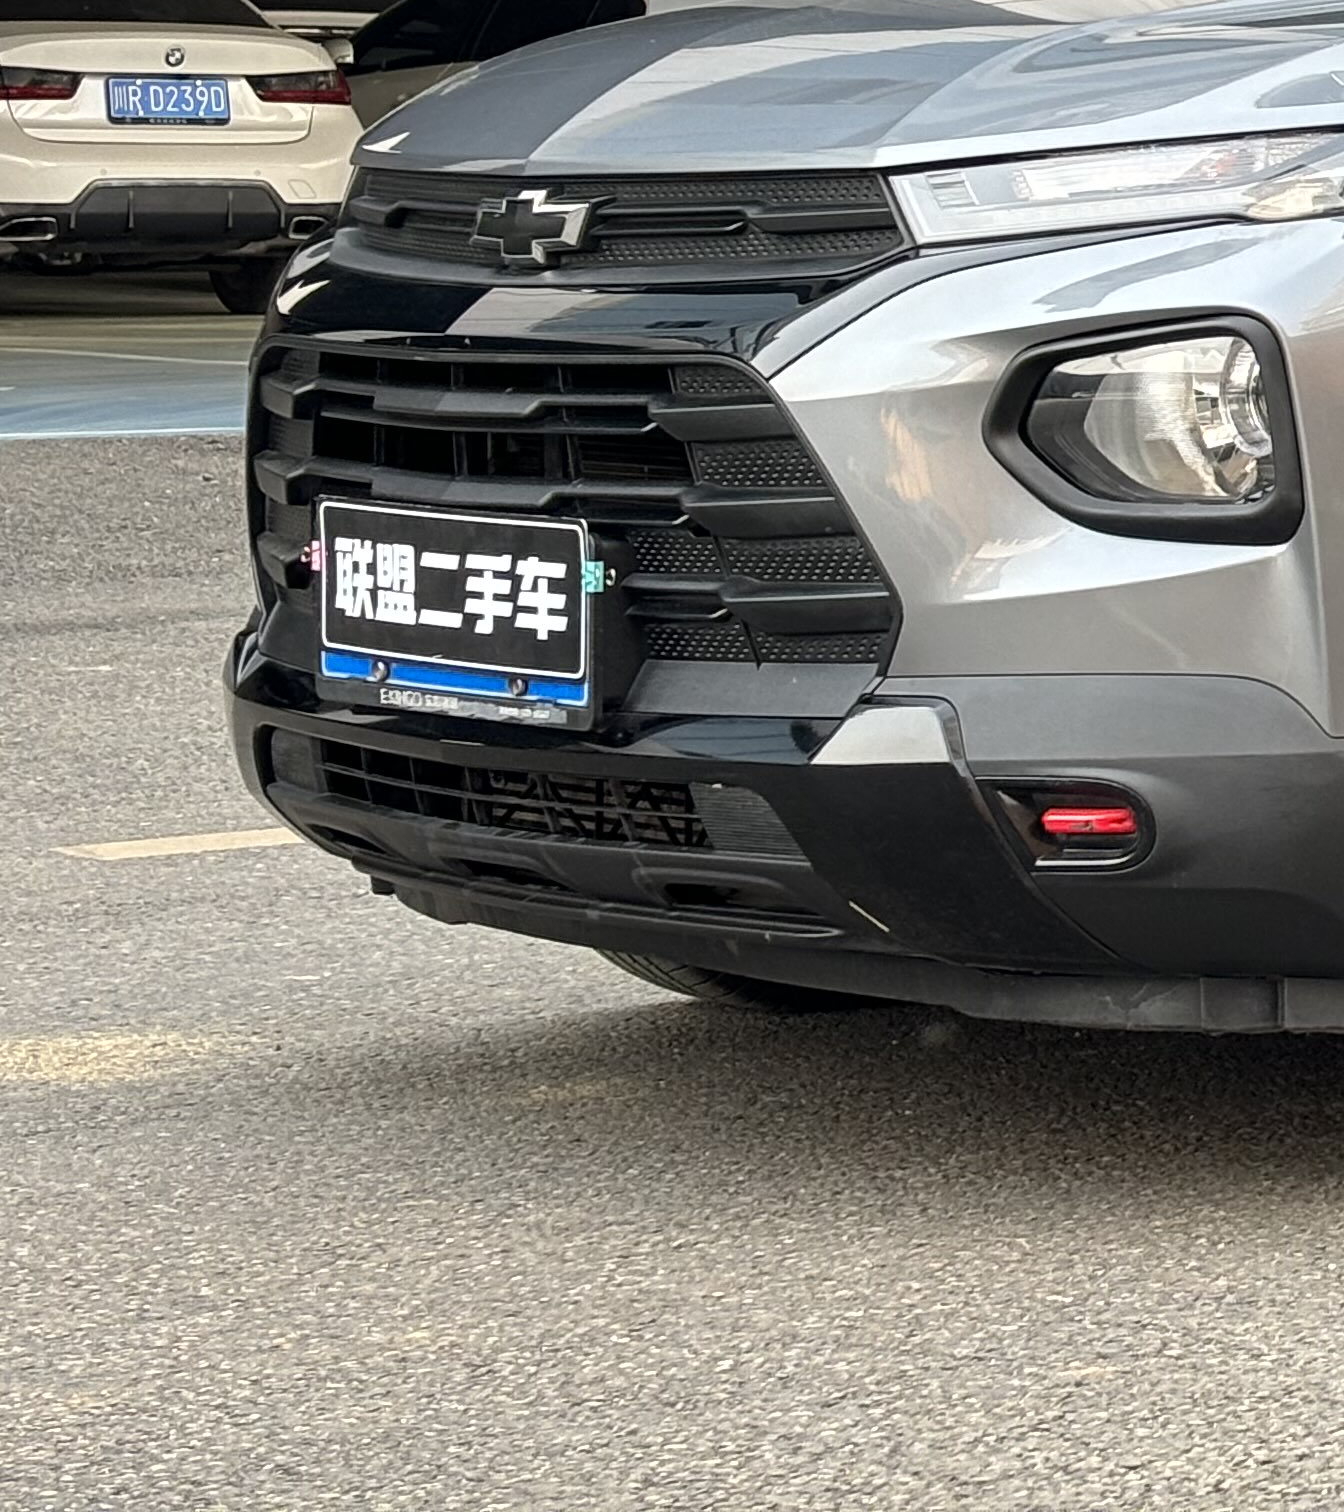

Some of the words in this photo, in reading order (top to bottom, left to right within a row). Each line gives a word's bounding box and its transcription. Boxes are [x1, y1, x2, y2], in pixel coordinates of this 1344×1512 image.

[334, 537, 569, 640] 联盟二手车
